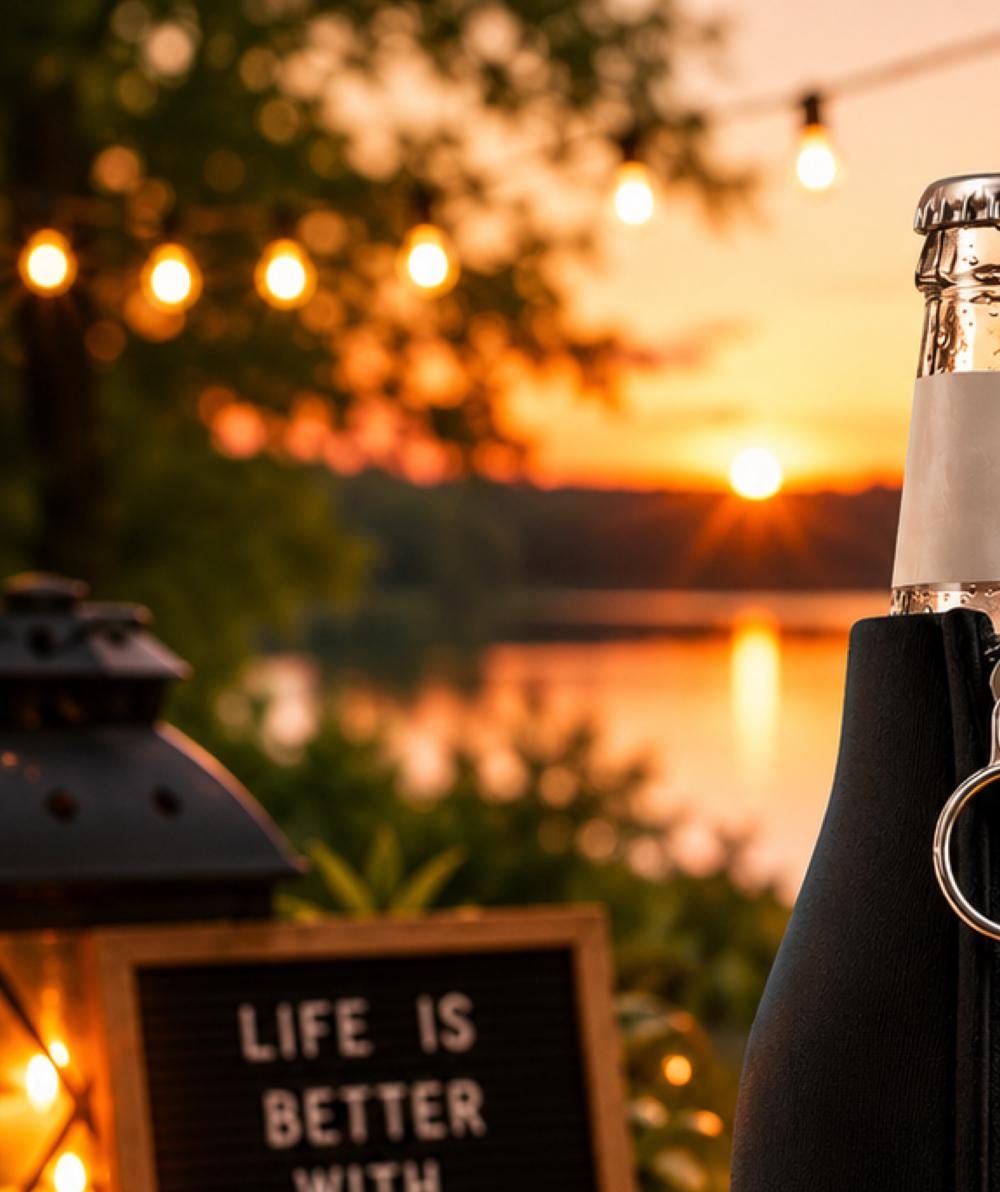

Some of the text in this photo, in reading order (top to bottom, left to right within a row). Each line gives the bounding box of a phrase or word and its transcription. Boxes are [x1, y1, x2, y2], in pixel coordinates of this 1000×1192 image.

[237, 991, 478, 1063] LIFE IS
[262, 1078, 487, 1149] BETTER
